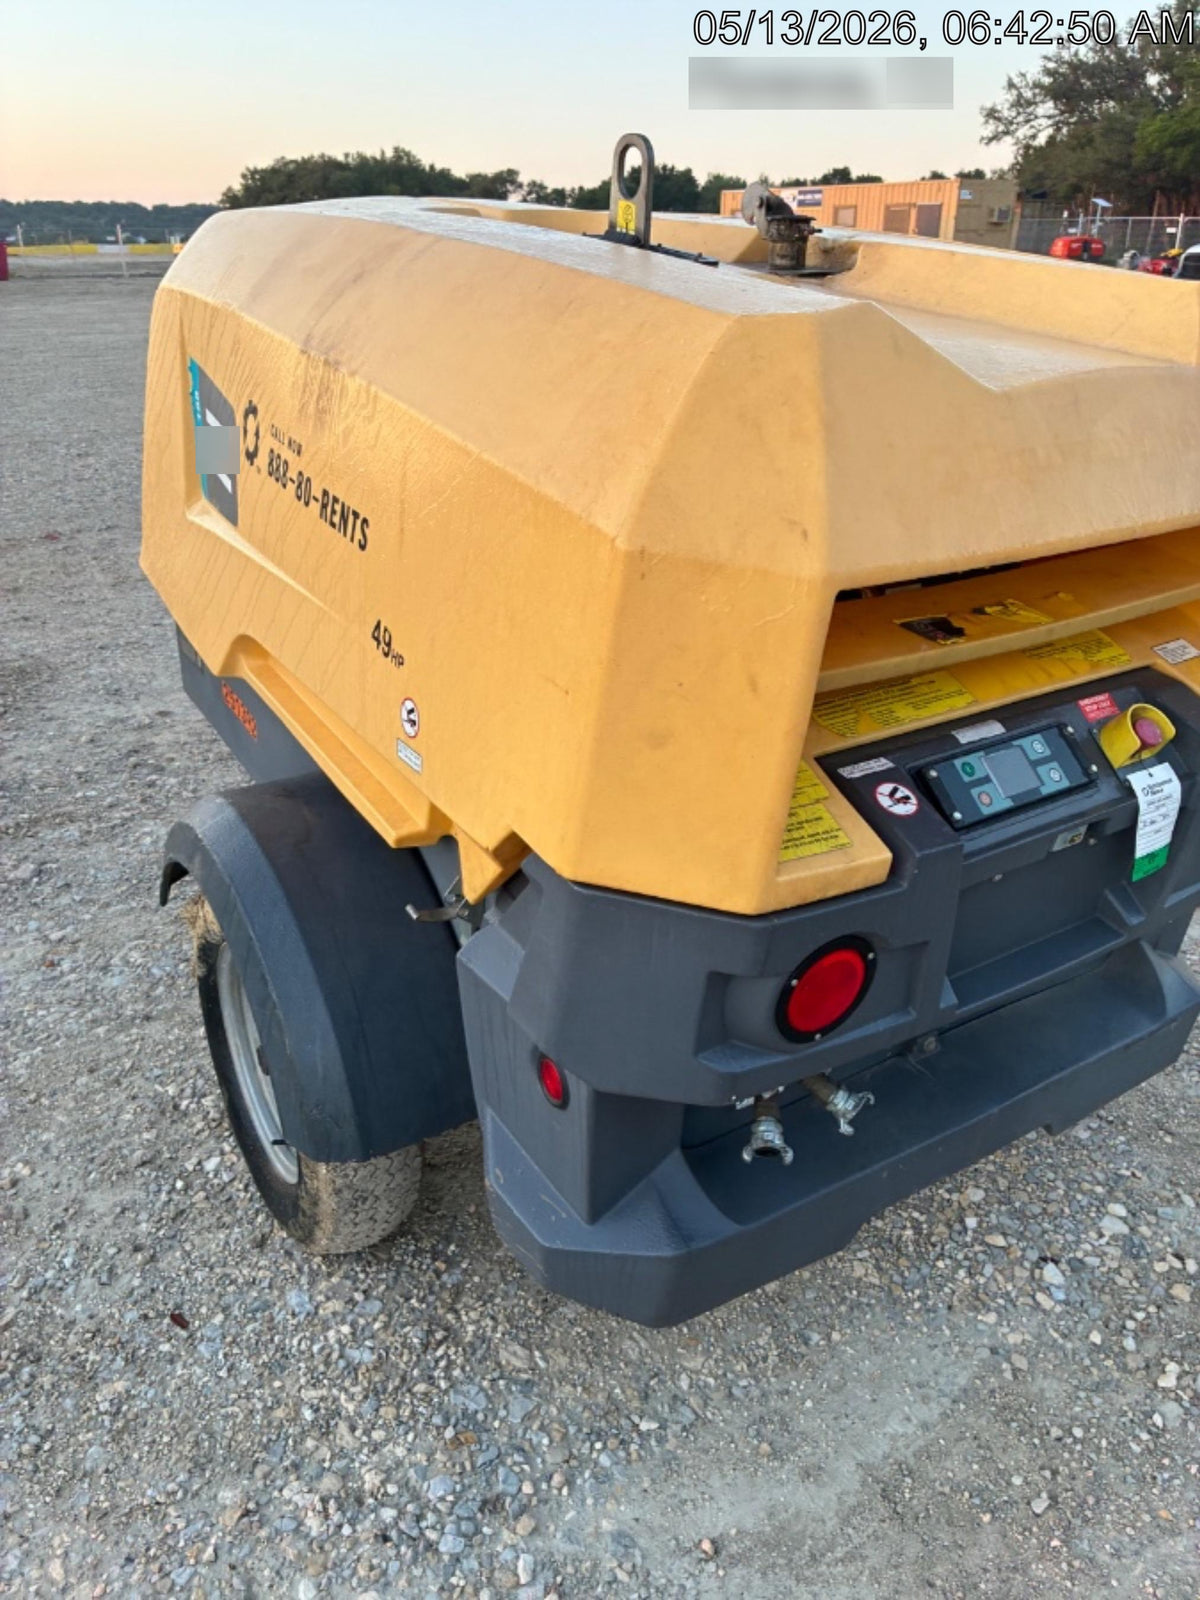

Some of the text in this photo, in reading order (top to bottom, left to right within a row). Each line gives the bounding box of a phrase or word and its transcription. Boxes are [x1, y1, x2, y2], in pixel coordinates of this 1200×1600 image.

[270, 424, 303, 458] CALL NOW
[267, 447, 370, 552] 888-80-RENTS
